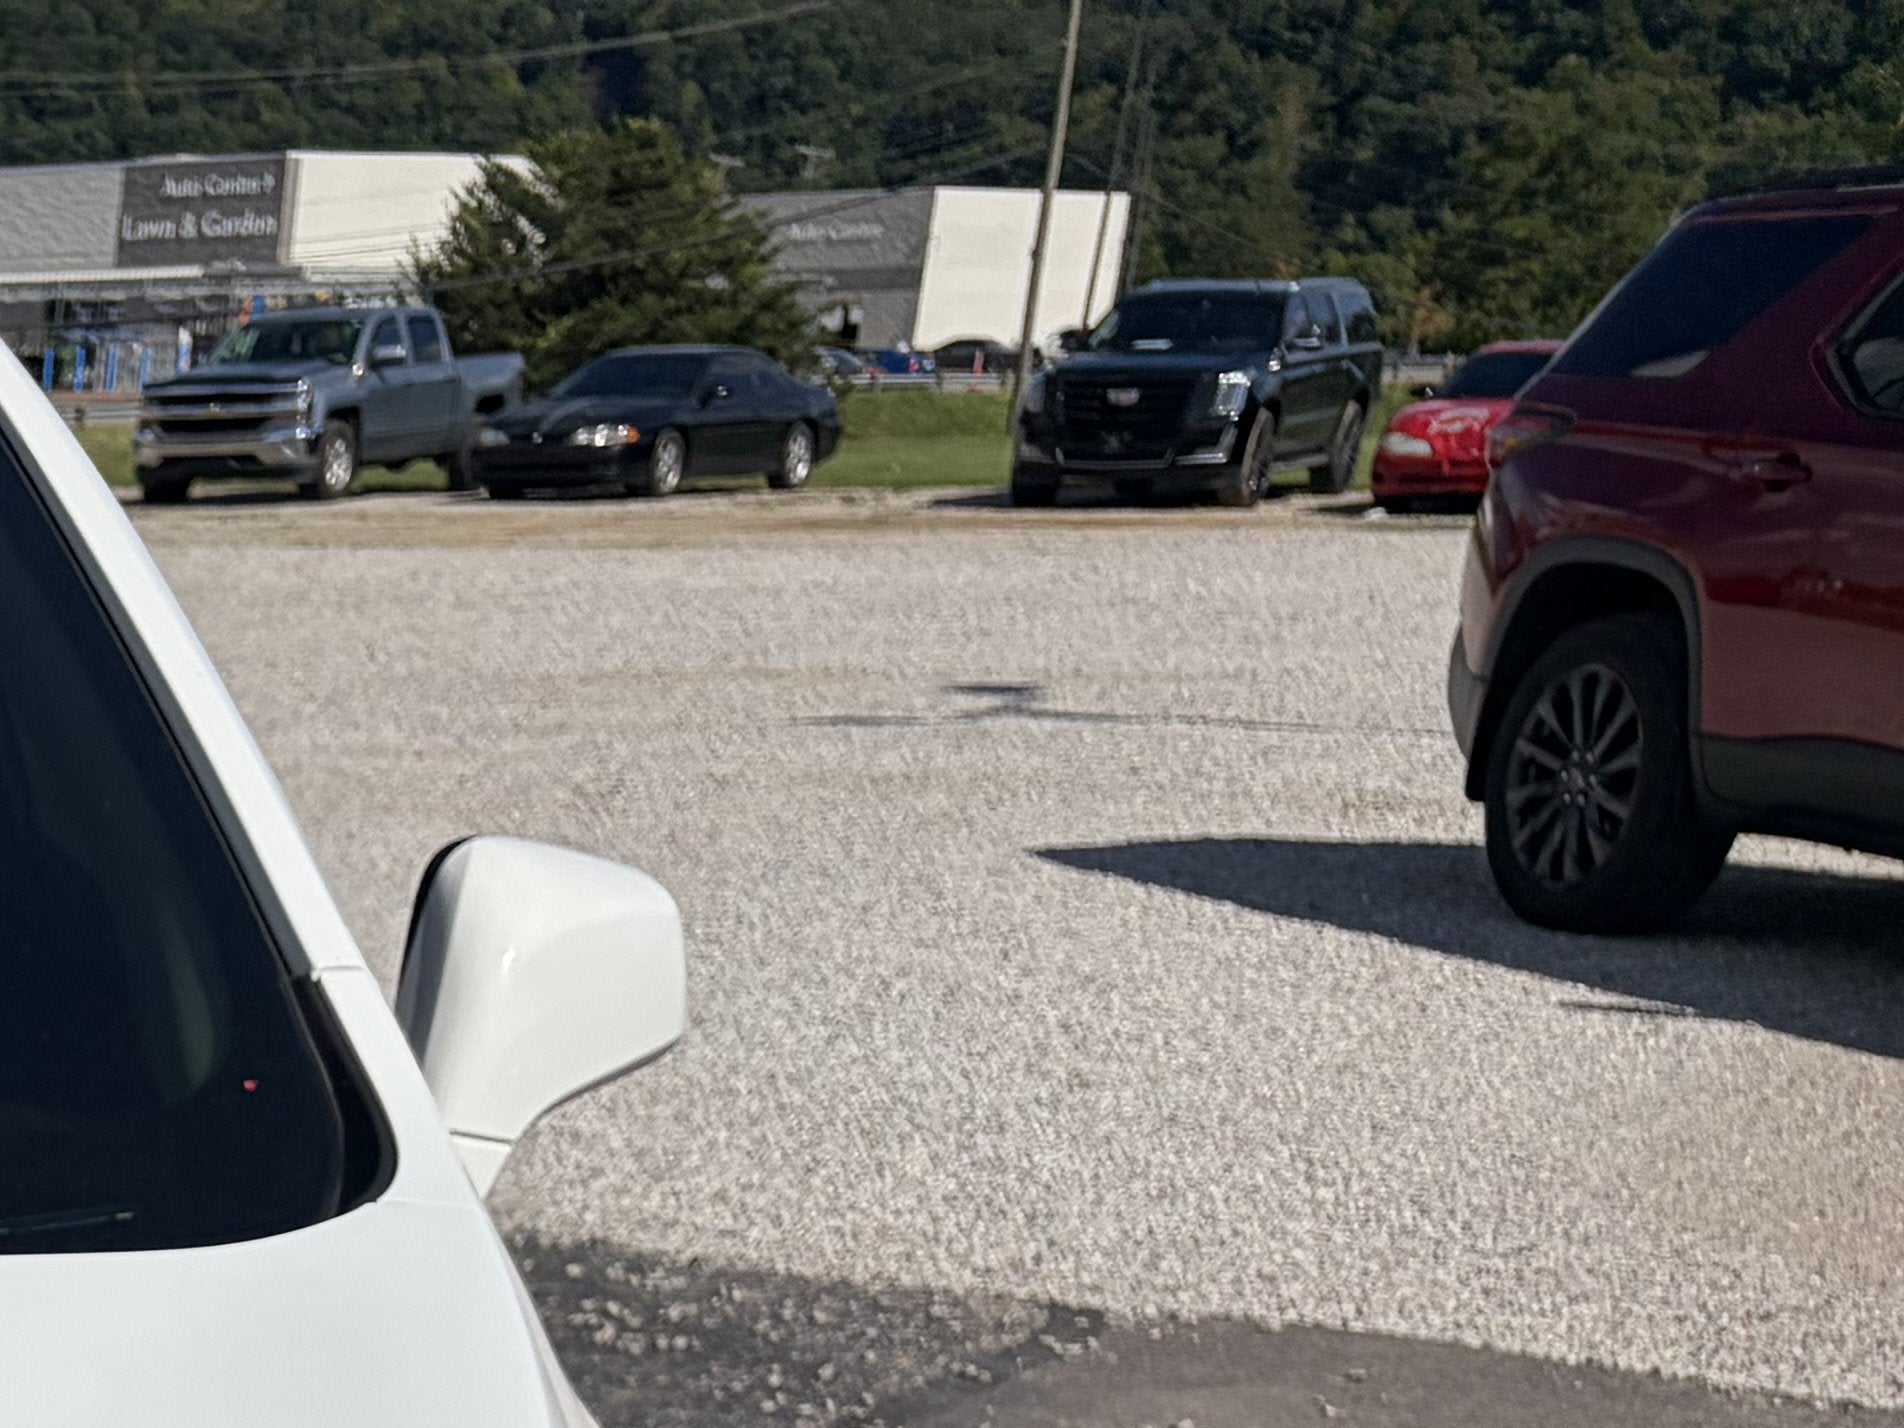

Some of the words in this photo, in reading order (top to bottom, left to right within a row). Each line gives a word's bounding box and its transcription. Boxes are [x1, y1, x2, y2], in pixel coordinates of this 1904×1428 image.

[160, 172, 203, 197] Auto
[122, 214, 176, 240] Lawn
[179, 211, 198, 239] &
[201, 210, 277, 237] Garden
